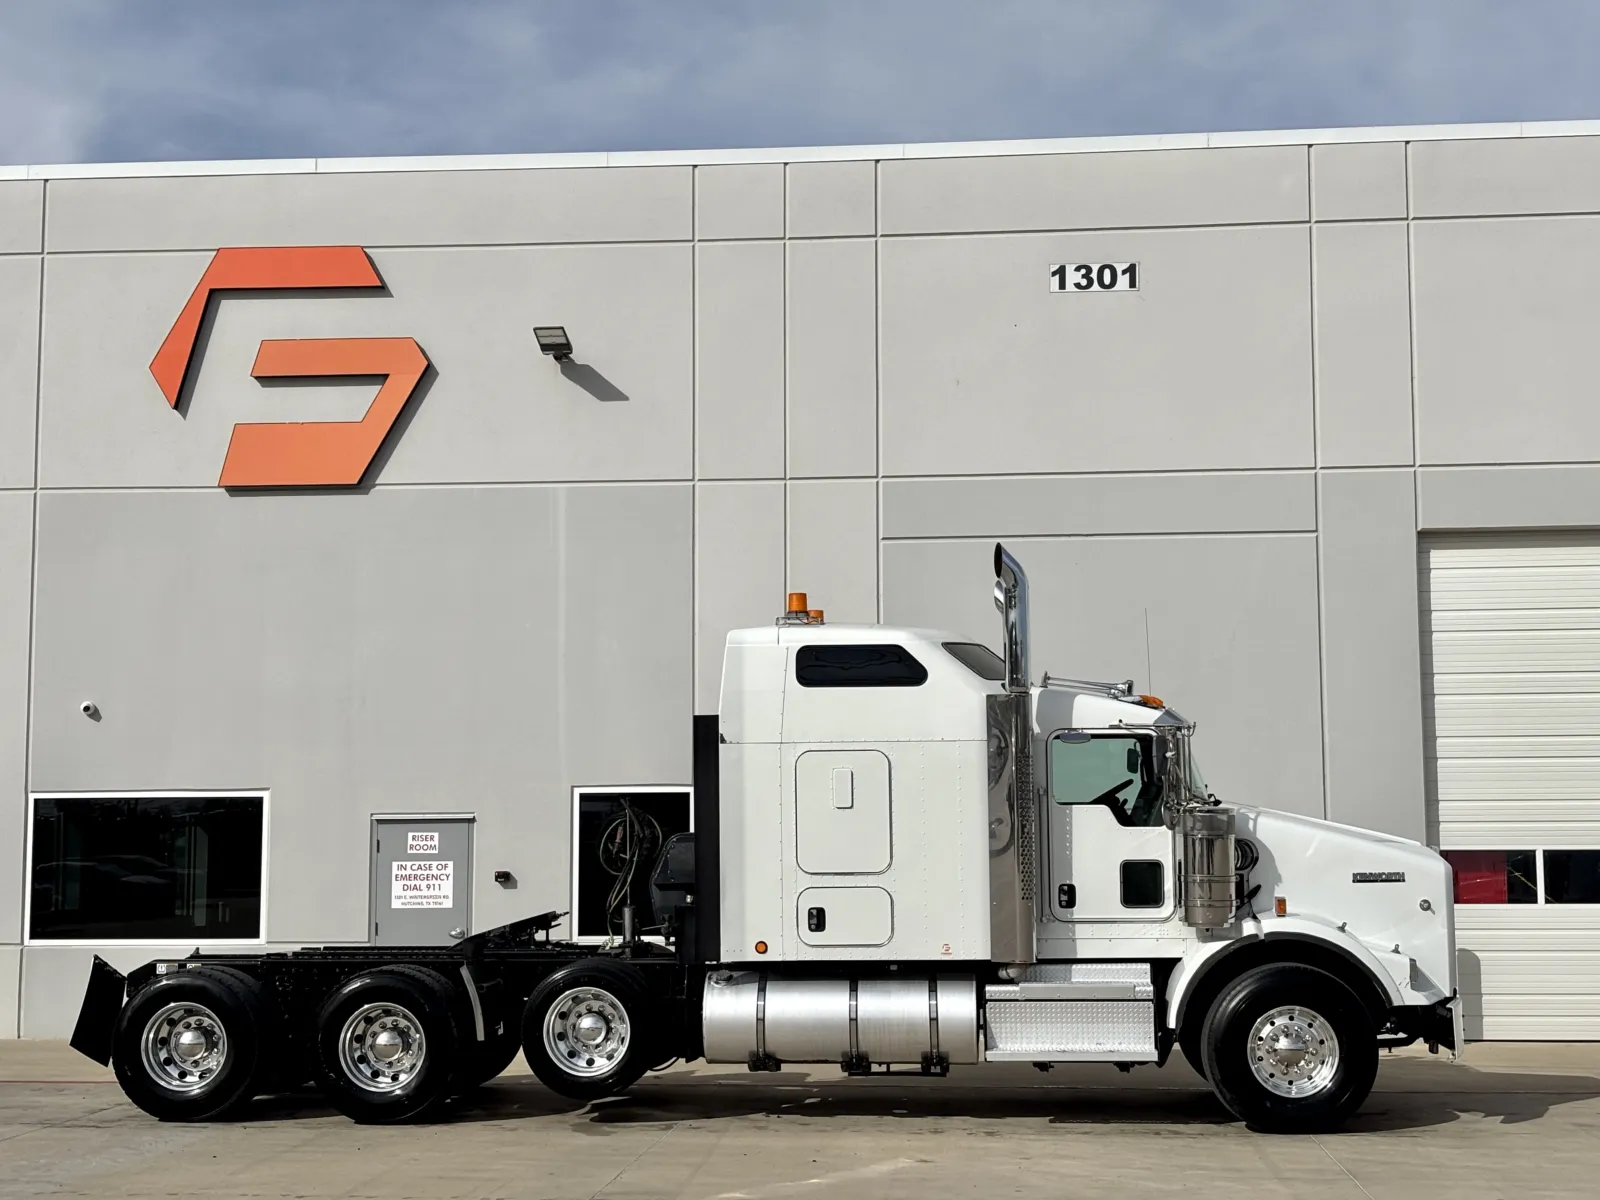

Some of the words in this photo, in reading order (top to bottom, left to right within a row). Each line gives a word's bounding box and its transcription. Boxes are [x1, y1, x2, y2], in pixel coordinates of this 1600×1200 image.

[1051, 263, 1136, 290] 1301
[411, 834, 435, 842] RISER
[394, 874, 450, 882] EMERGENCY
[402, 884, 423, 892] DIAL
[426, 884, 441, 892] 911
